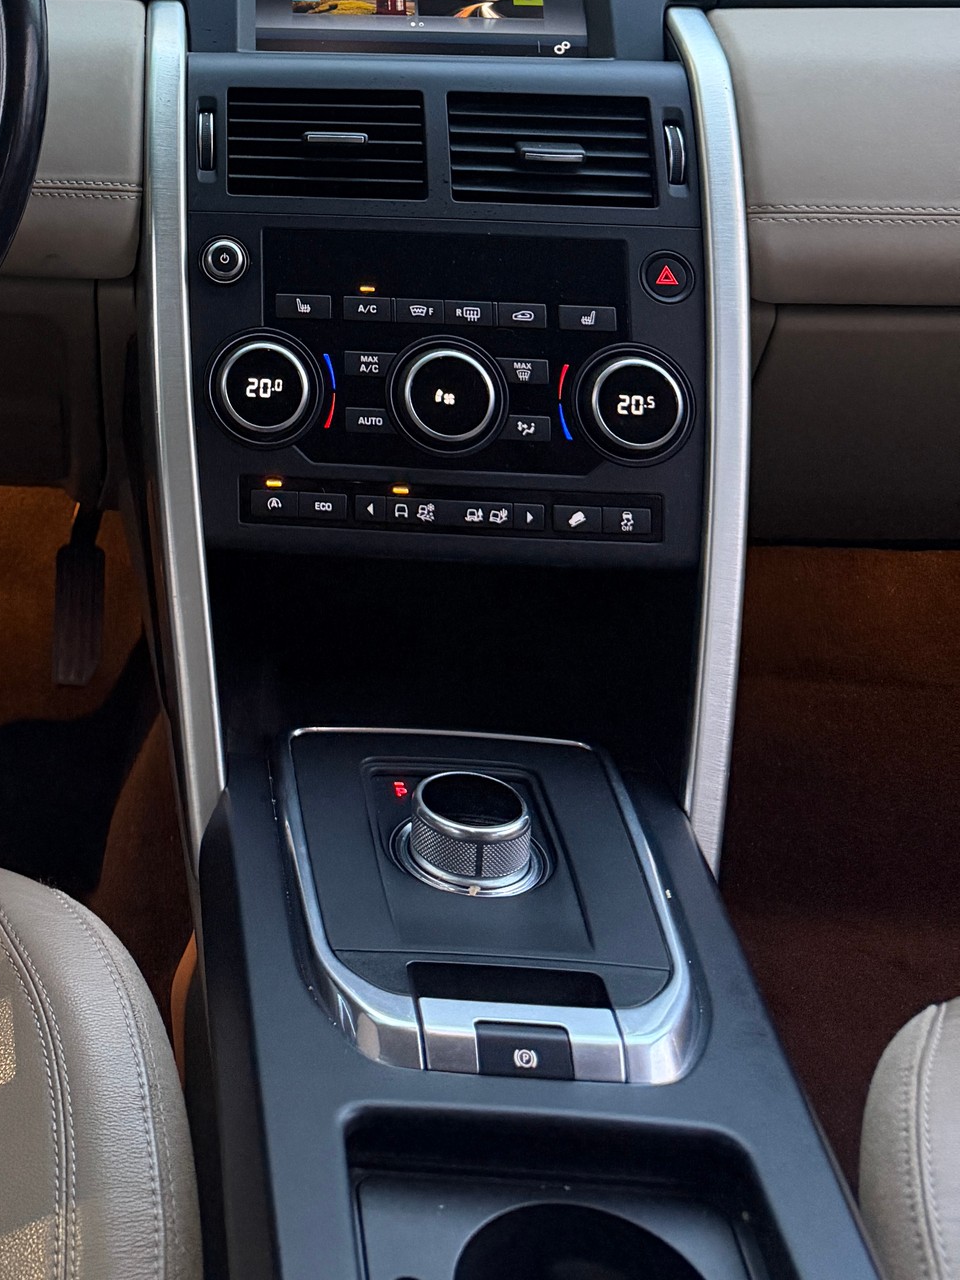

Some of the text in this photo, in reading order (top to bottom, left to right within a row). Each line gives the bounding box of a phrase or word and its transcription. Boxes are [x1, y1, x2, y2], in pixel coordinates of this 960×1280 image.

[357, 304, 377, 314] A/C
[428, 307, 434, 316] F
[455, 308, 462, 317] R
[360, 355, 379, 363] MAX
[359, 364, 379, 373] A/C
[513, 362, 532, 370] MAX
[357, 416, 383, 426] AUTO
[314, 501, 333, 512] ECO
